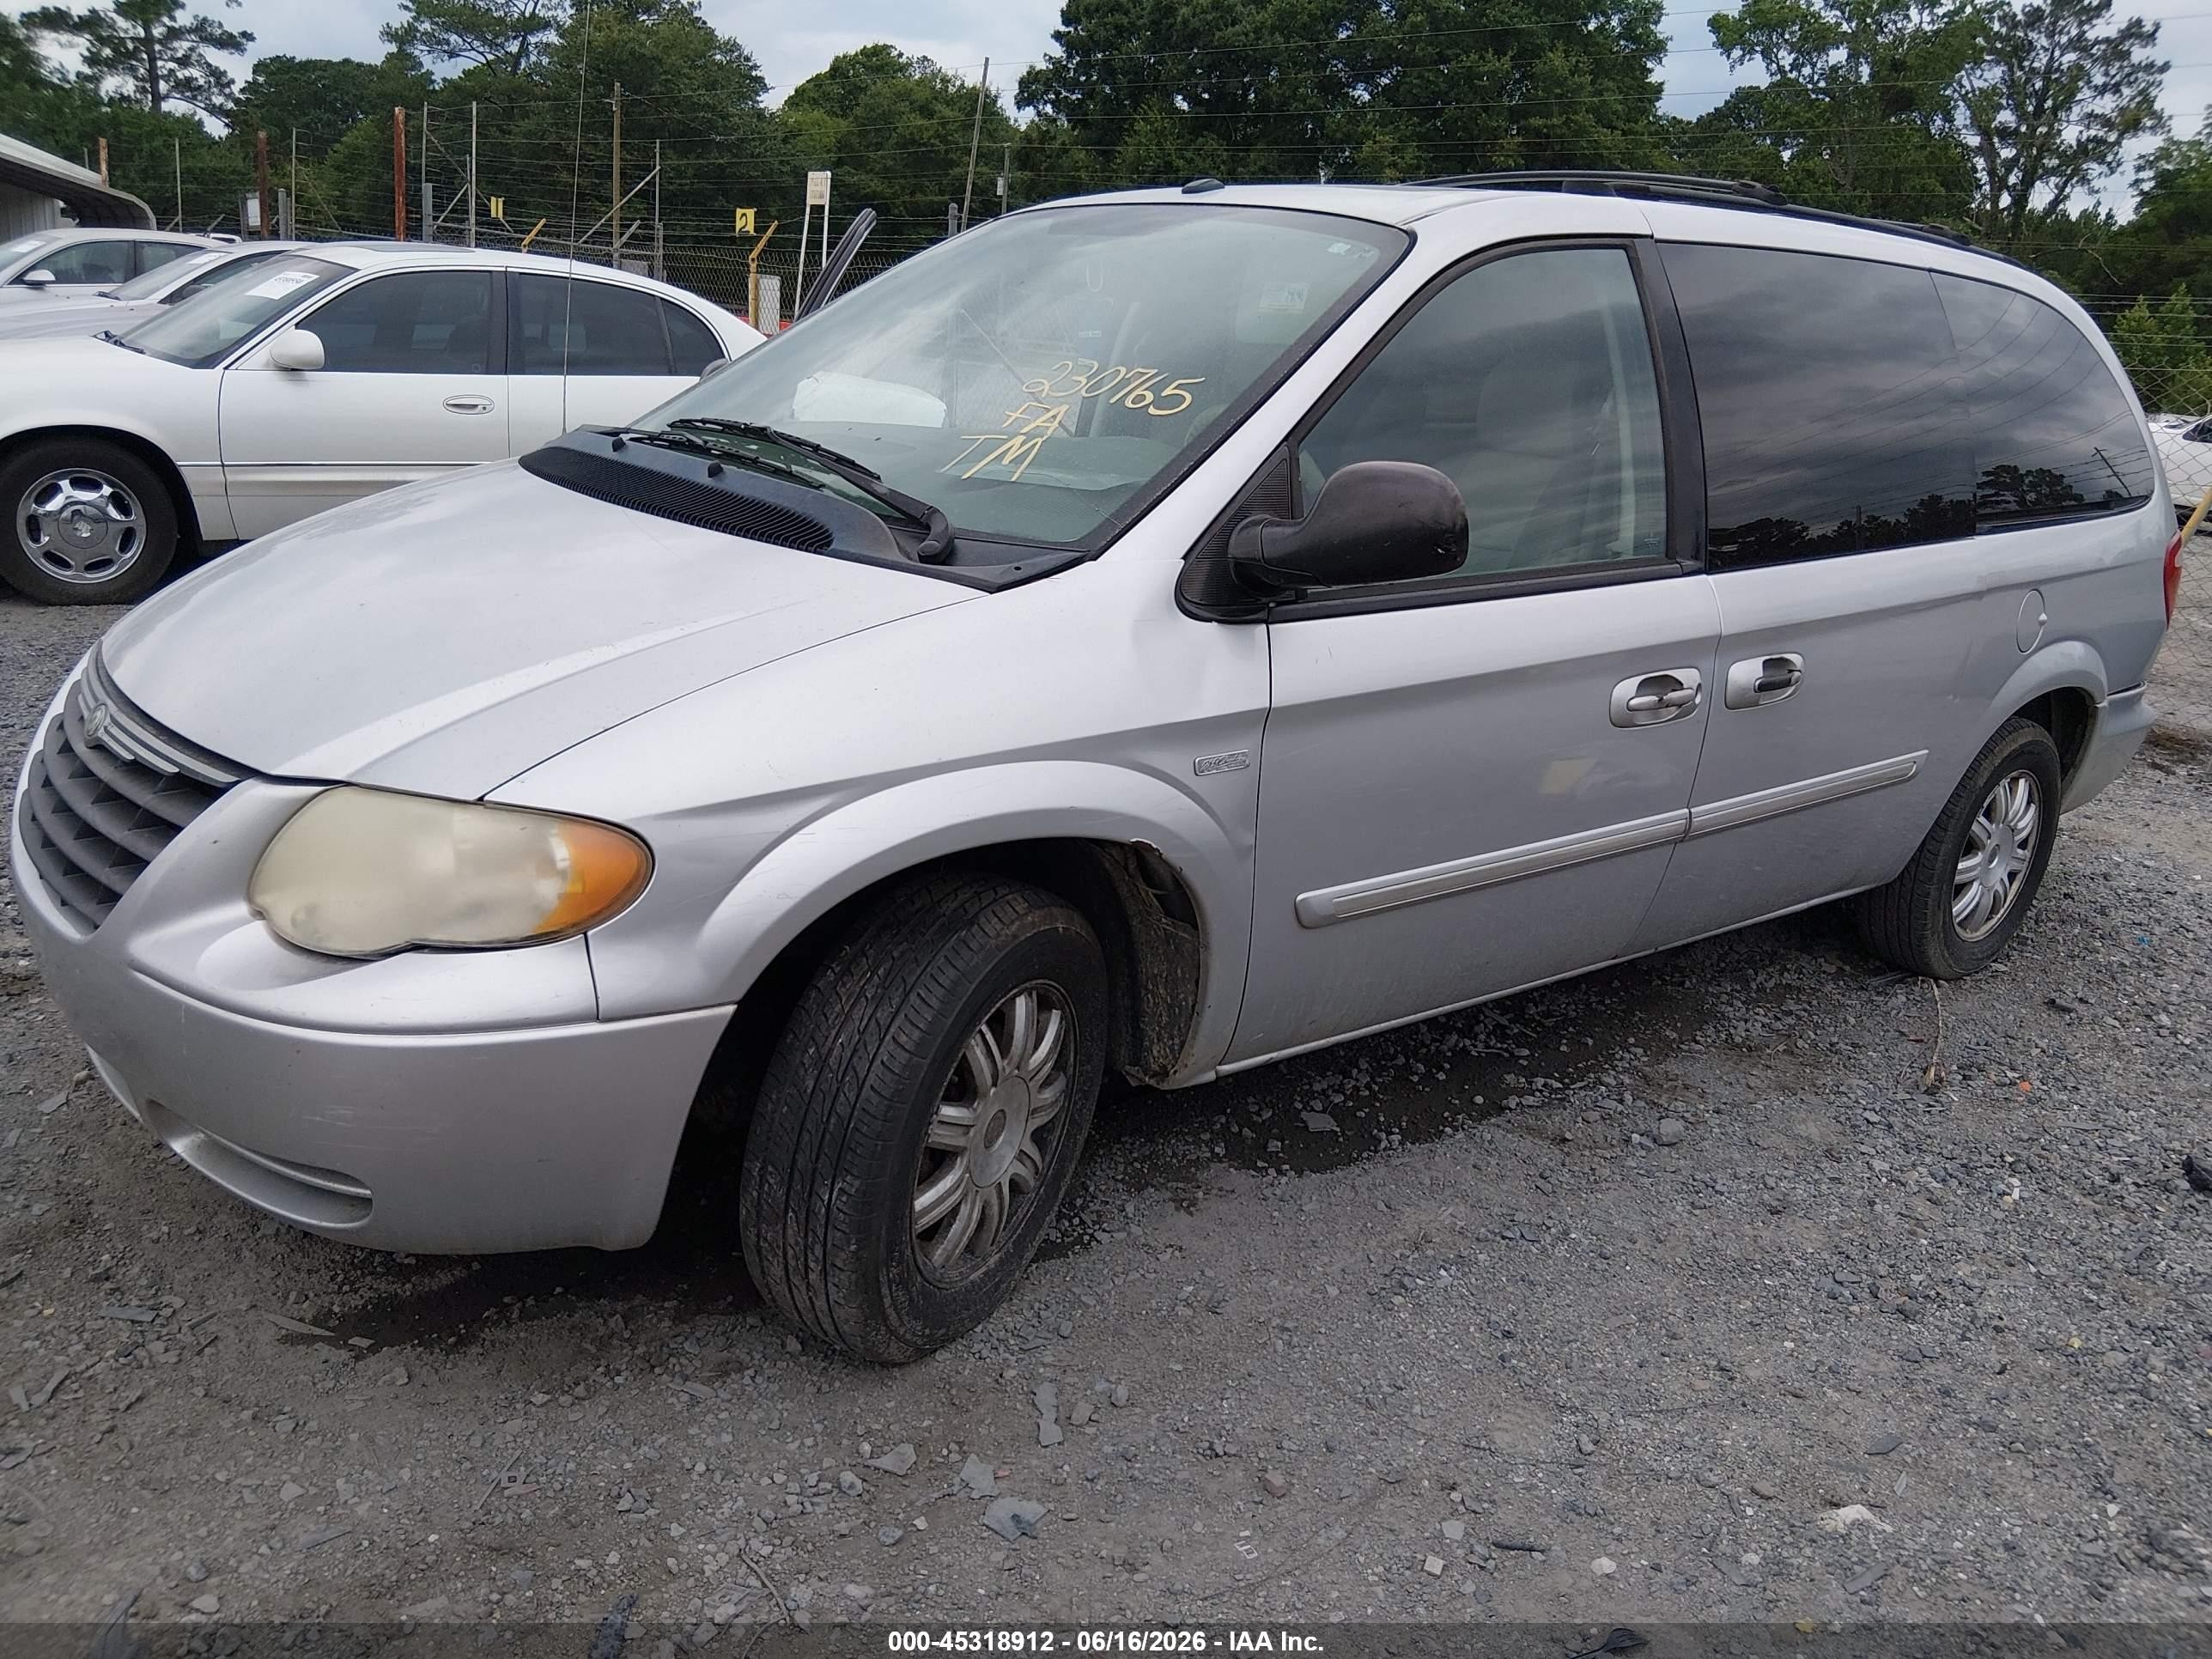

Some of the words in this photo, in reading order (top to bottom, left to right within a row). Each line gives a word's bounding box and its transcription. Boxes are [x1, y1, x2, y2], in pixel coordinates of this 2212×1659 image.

[738, 212, 750, 234] 2
[1022, 359, 1206, 416] 230765
[1002, 401, 1070, 439] FA
[940, 434, 1044, 481] TM
